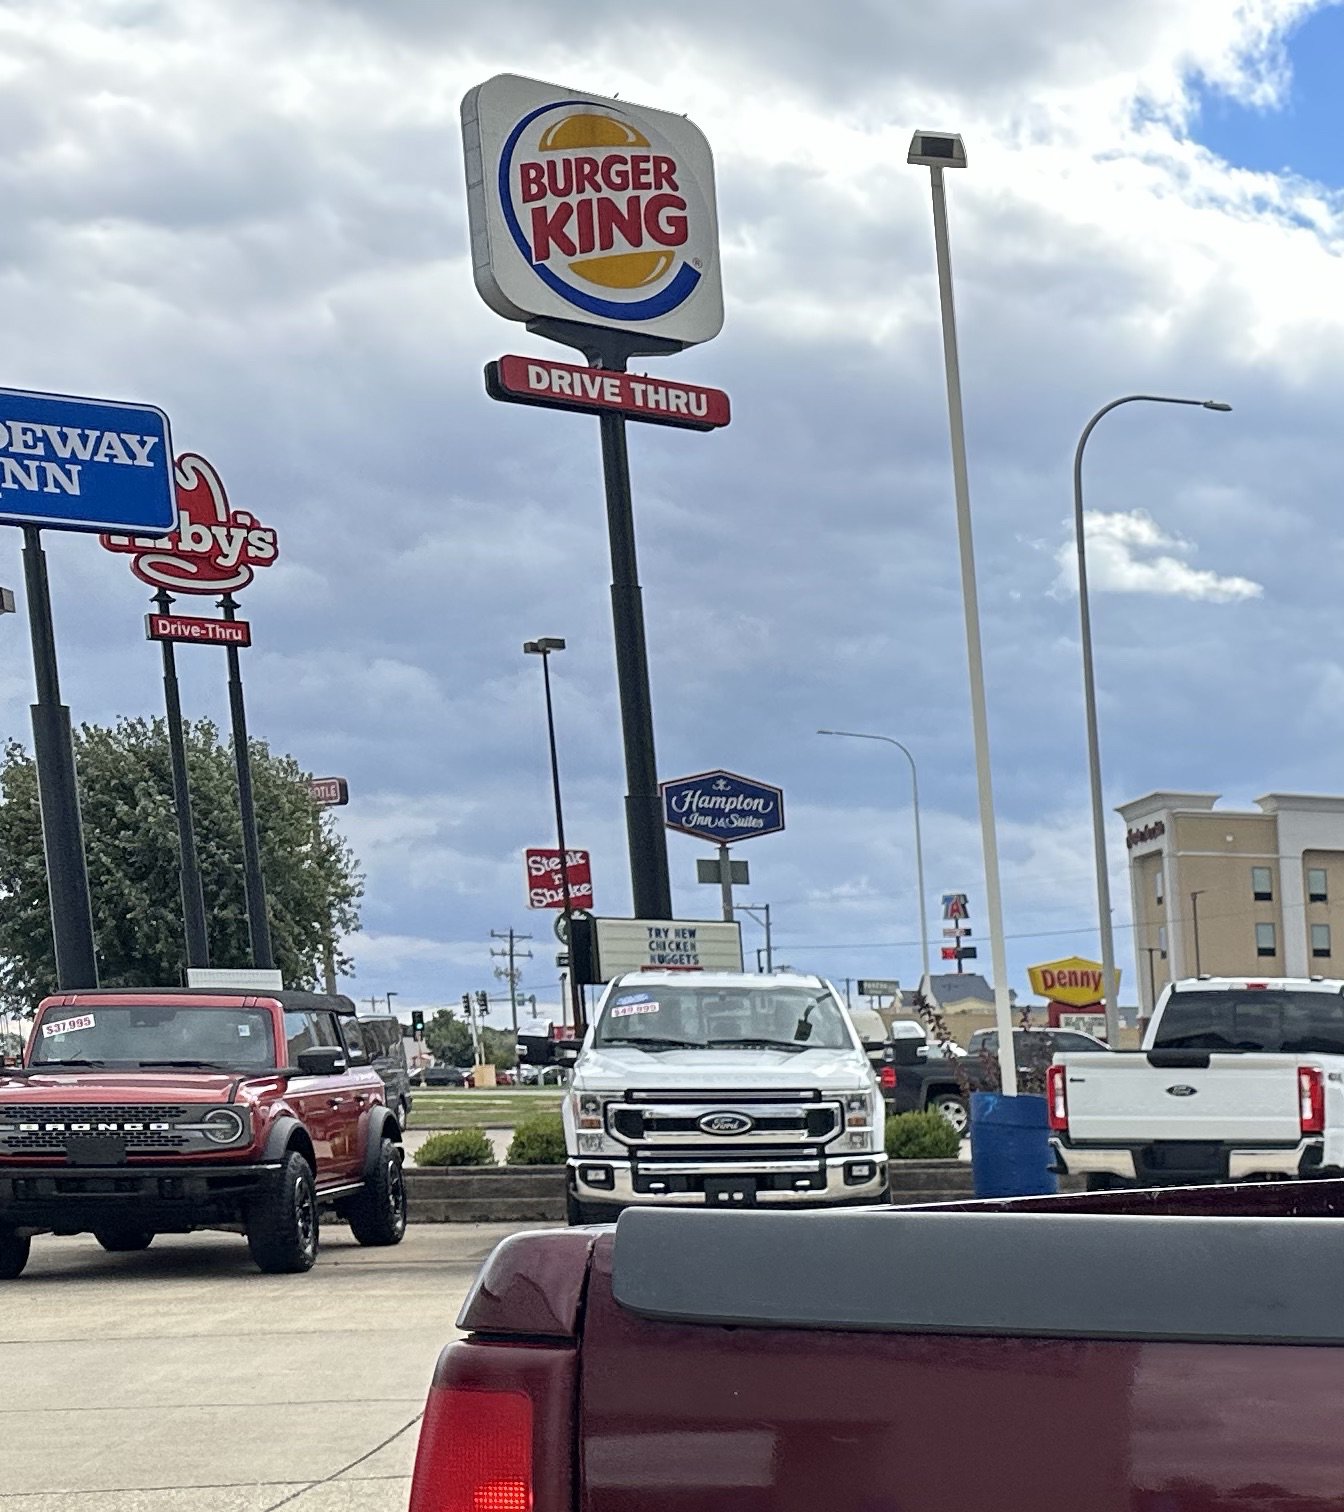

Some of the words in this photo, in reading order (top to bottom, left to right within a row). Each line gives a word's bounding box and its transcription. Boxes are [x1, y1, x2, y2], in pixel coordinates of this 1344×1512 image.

[519, 154, 680, 204] BURGER
[531, 193, 689, 262] KING
[527, 364, 622, 403] DRIVE
[630, 382, 708, 417] THRU
[0, 420, 158, 468] EWAY
[0, 457, 81, 498] NN
[110, 511, 274, 567] by's
[157, 619, 242, 641] Drive-Thru
[671, 789, 774, 814] Hampton
[682, 812, 718, 828] Inn
[726, 813, 763, 829] Suites
[647, 927, 669, 939] TRY
[674, 928, 697, 939] NEW
[648, 940, 697, 953] CHICKEN
[650, 953, 699, 965] NUGGETS
[19, 1123, 169, 1131] BRONCO
